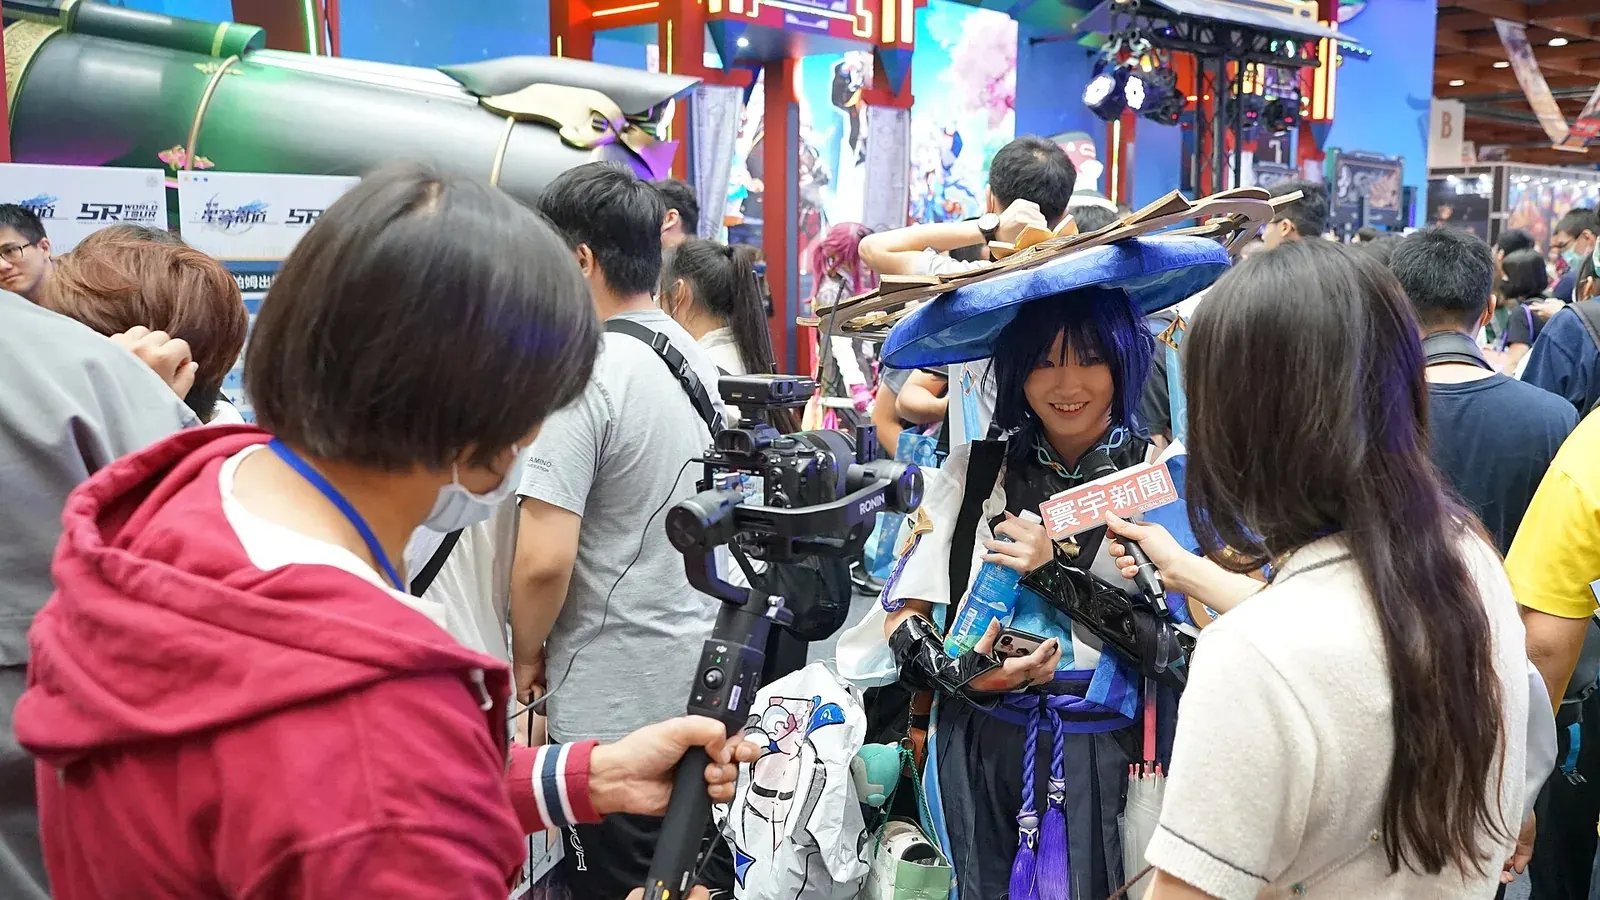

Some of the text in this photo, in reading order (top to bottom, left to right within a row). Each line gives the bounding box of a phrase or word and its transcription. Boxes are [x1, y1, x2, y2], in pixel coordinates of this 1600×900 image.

[1441, 111, 1452, 139] B
[76, 203, 123, 221] SR
[123, 210, 157, 219] TOUR
[236, 274, 276, 290] 帕姆出
[859, 492, 886, 516] RONIN
[1046, 468, 1170, 533] 寰宇新聞
